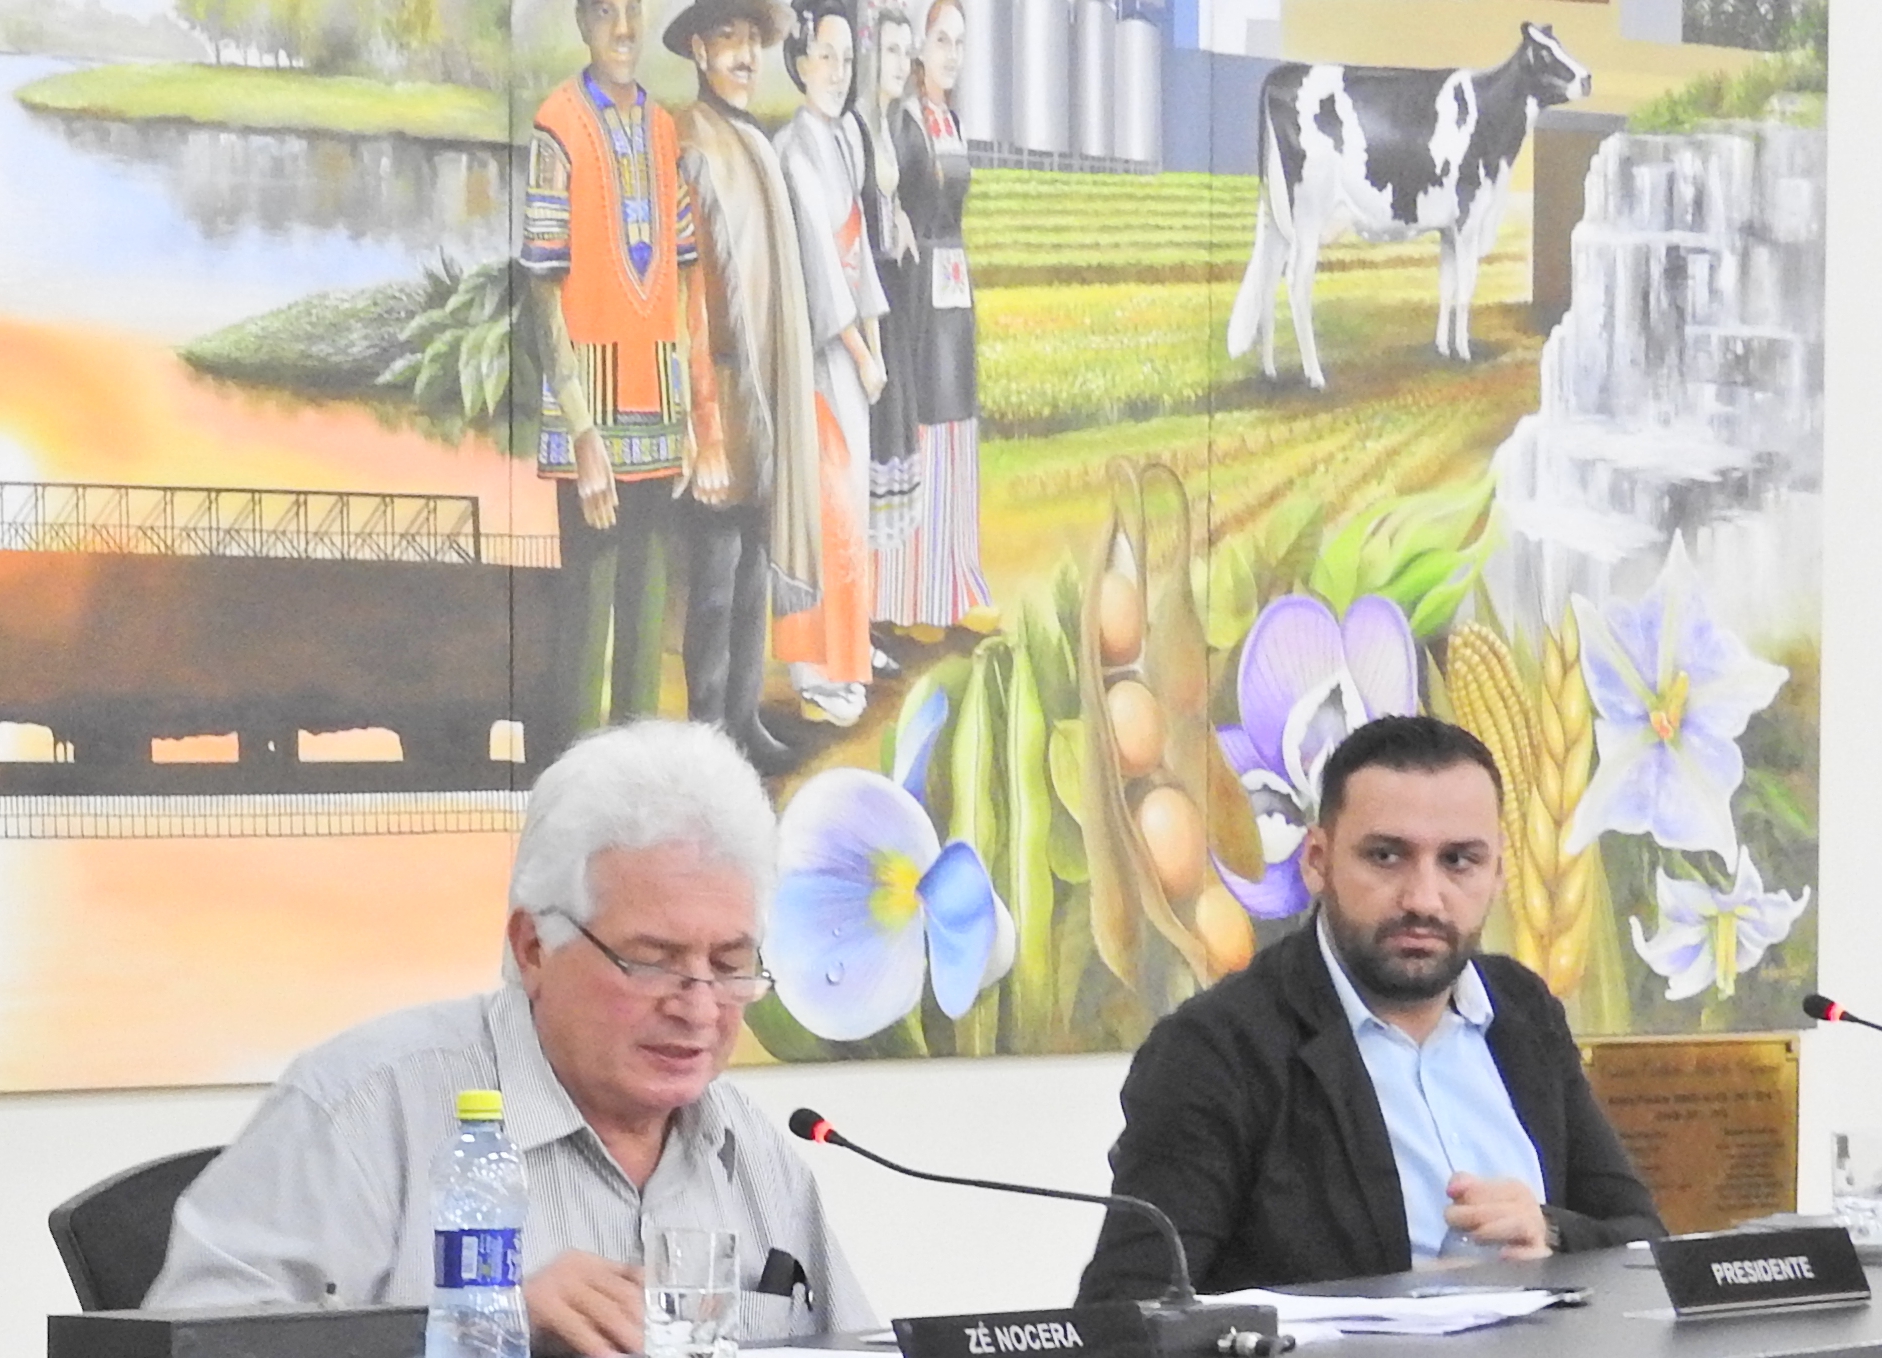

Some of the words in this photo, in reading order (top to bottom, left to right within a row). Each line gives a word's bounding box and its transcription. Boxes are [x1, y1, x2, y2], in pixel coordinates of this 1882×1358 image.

[1710, 1256, 1815, 1286] PRESIDENTE
[964, 1321, 996, 1354] ZÉ
[994, 1321, 1084, 1352] NOCERA
